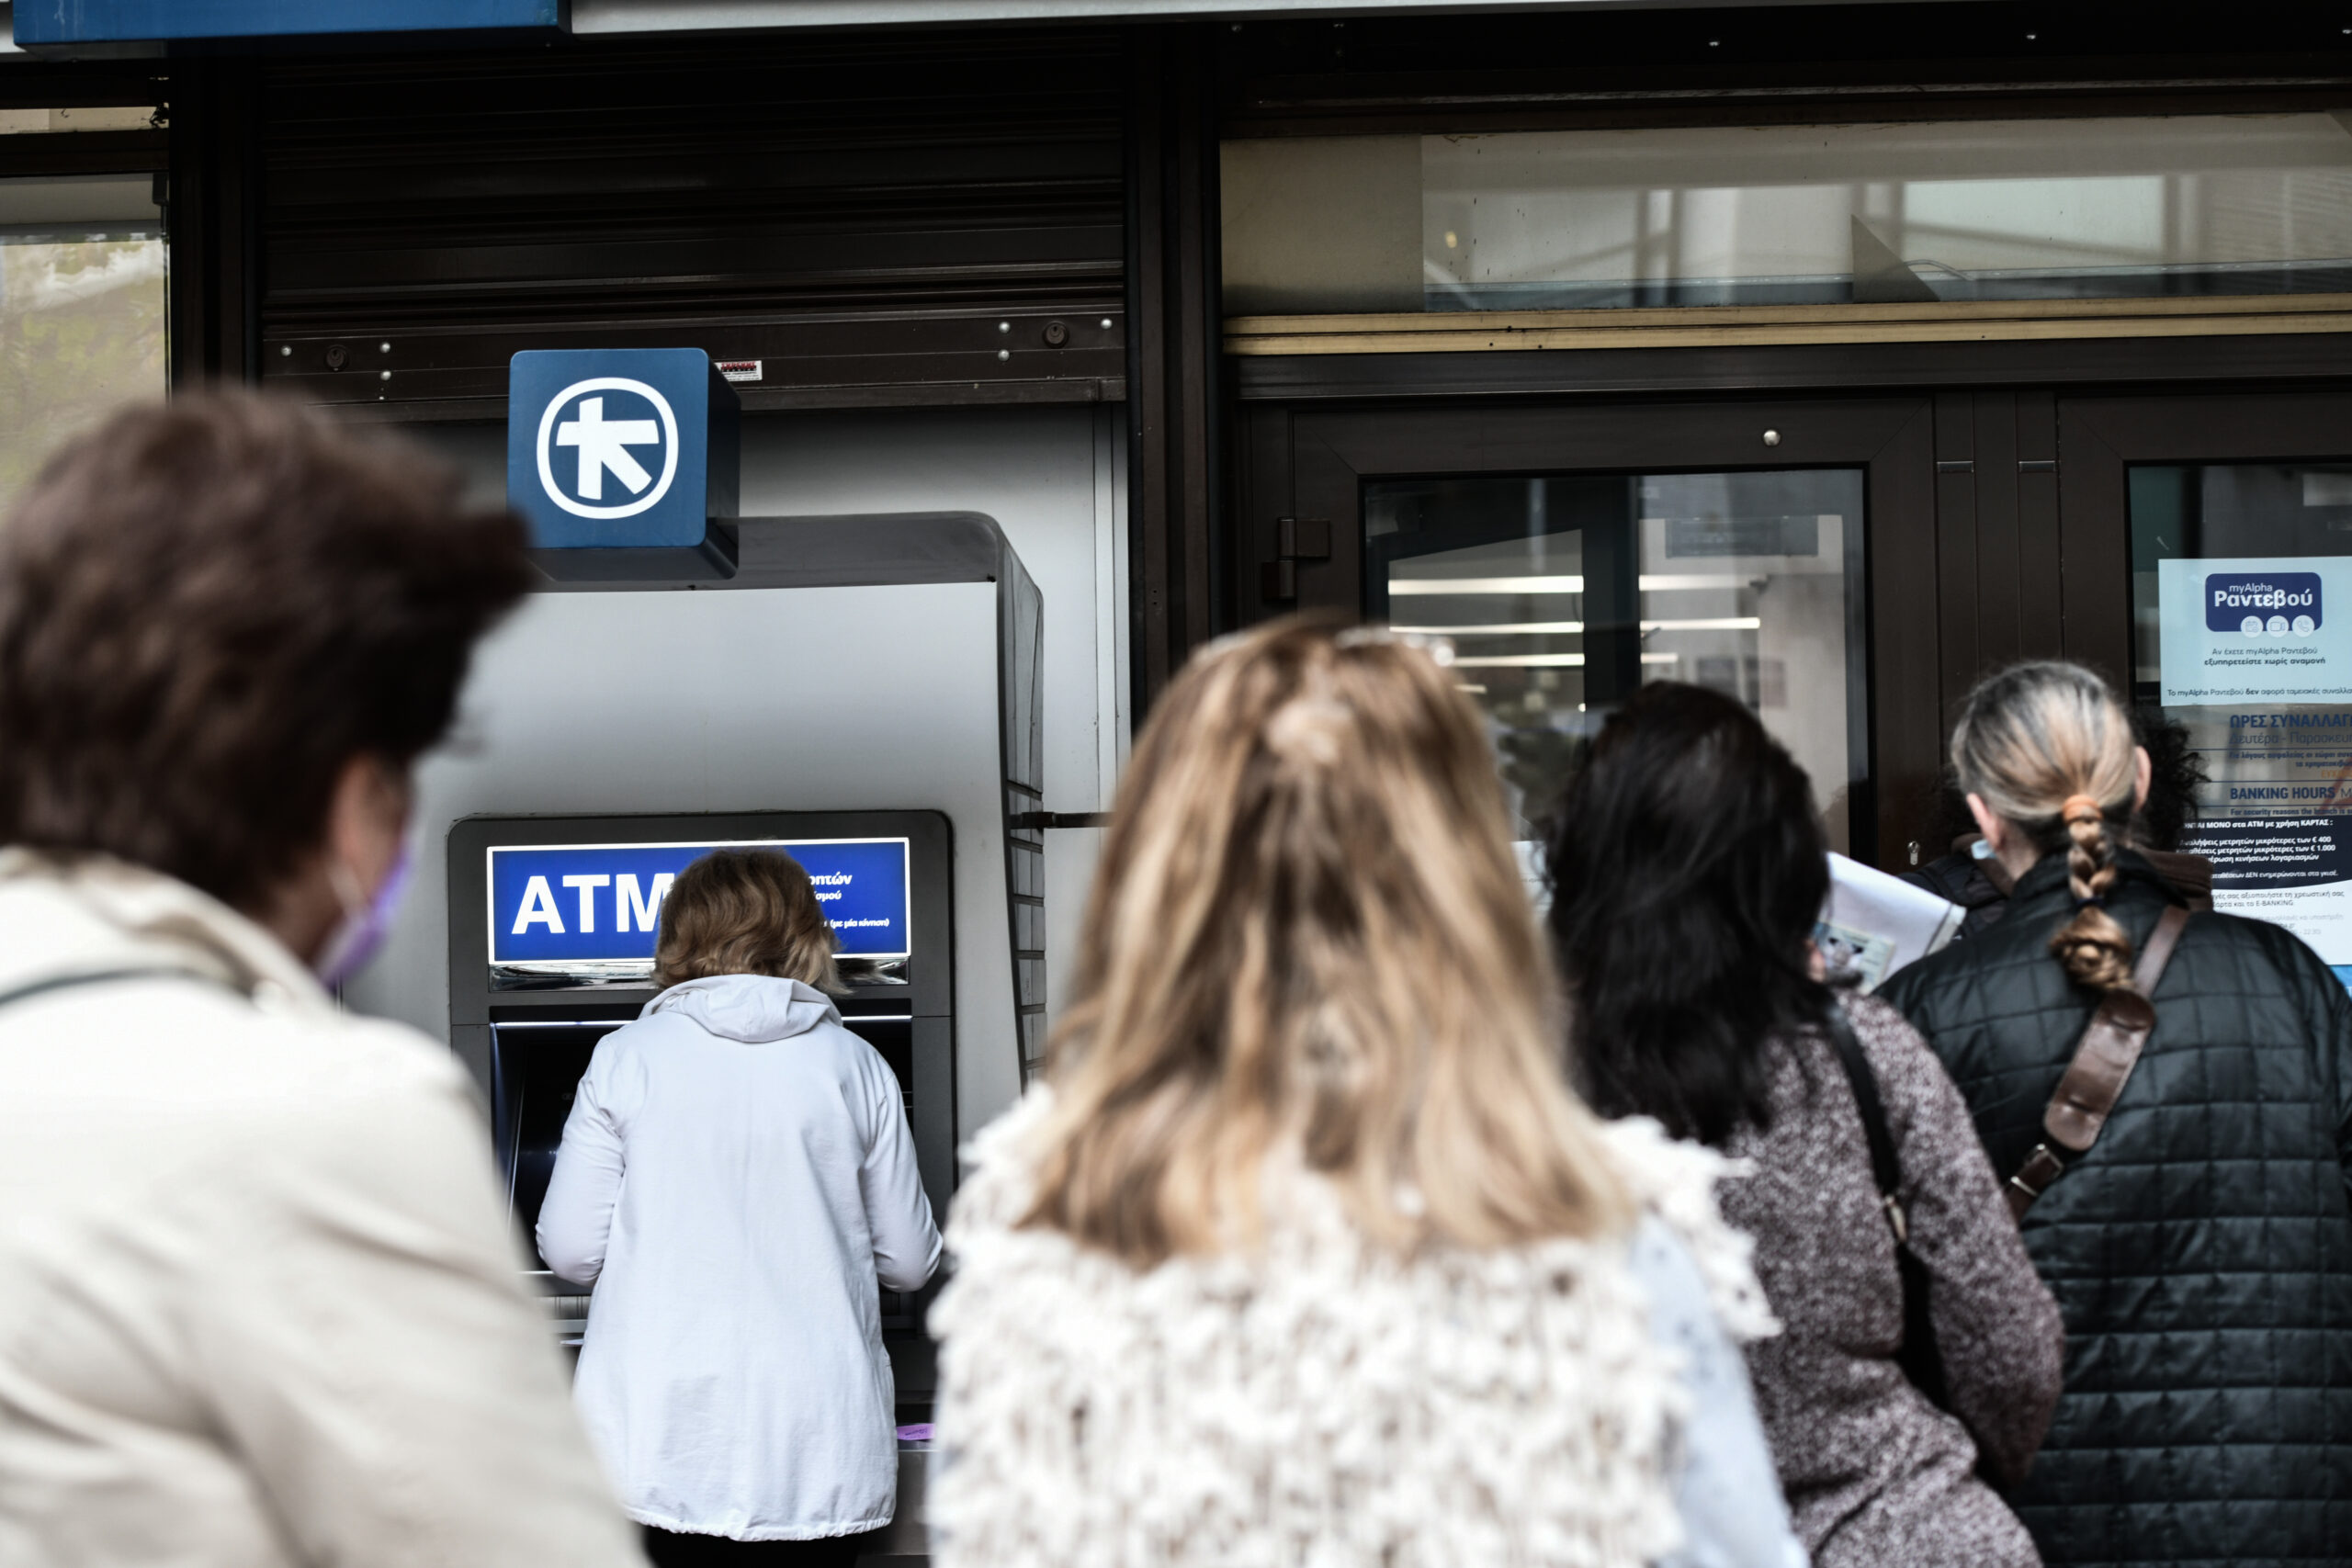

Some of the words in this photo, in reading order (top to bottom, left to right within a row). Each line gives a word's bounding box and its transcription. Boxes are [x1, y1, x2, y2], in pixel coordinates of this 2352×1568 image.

[2229, 582, 2273, 593] myAlpha
[2214, 588, 2313, 610] Ραντεβού
[2245, 647, 2279, 657] myAlpha
[2281, 646, 2318, 656] Ραντεβού
[2204, 658, 2261, 667] εξυπηρετείστε
[2264, 657, 2288, 666] χωρίς
[2290, 656, 2325, 665] αναμονή
[2177, 688, 2209, 697] myAlpha
[2211, 687, 2244, 696] Ραντεβού
[2245, 687, 2259, 695] δεν
[2230, 715, 2267, 728] ΩΡΕΣ
[2229, 732, 2278, 746] Δευτέρα
[2230, 787, 2289, 799] BANKING
[2292, 786, 2335, 799] HOURS
[2244, 807, 2270, 817] security
[2276, 819, 2300, 829] χρήση
[2219, 837, 2255, 847] μετρητών
[2256, 836, 2296, 846] μικρότερες
[2217, 845, 2253, 855] μετρητών
[2254, 845, 2294, 854] μικρότερες
[2234, 854, 2269, 863] κινήσεων
[2270, 852, 2320, 863] λογαριασμών
[511, 873, 675, 934] ATM
[2256, 899, 2294, 908] E-BANKING
